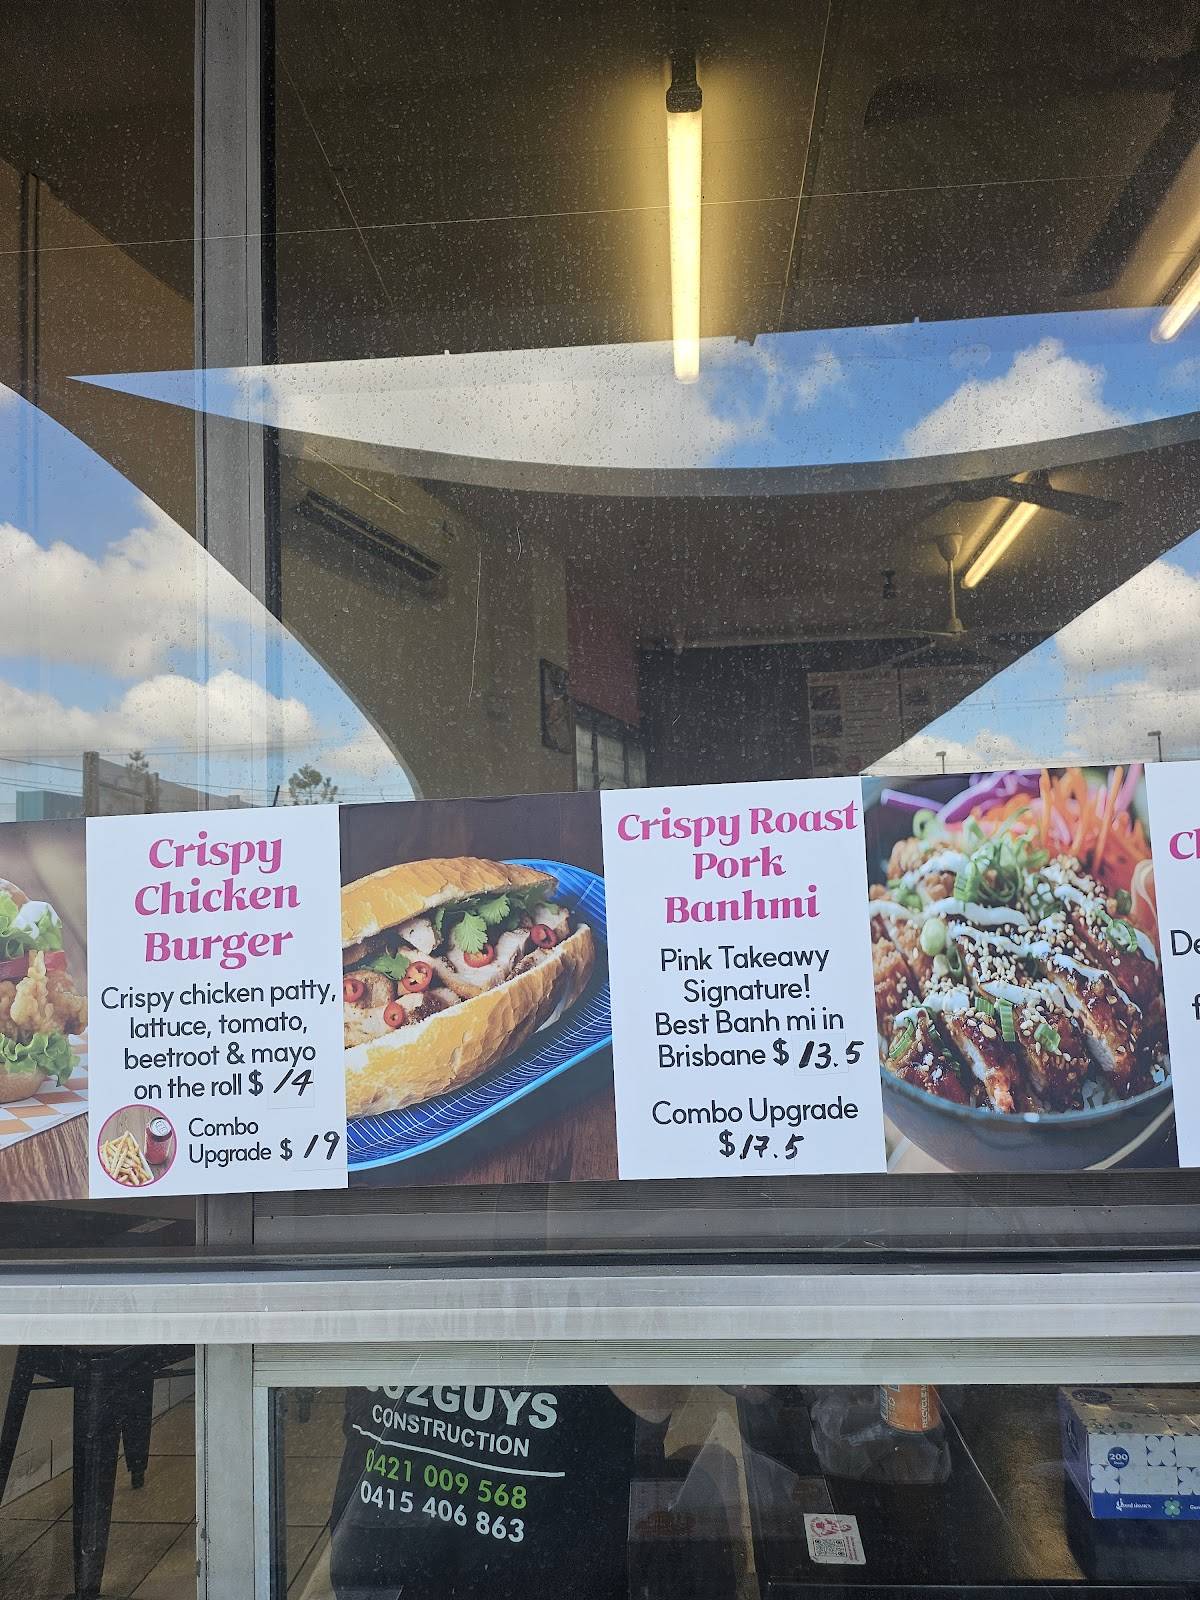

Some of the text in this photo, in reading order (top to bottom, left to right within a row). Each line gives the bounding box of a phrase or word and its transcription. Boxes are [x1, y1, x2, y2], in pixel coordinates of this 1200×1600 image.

[617, 801, 858, 848] Crispy Roast
[148, 831, 282, 875] Crispy
[693, 846, 787, 881] Pork
[134, 877, 301, 917] Chicken
[665, 884, 822, 924] Banhmi
[145, 930, 294, 970] Burger
[660, 945, 830, 972] Pink Takeawy
[101, 979, 336, 1014] Crispy chicken patty,
[683, 973, 812, 1008] Signature!
[130, 1011, 308, 1039] lattuce, tomato,
[655, 1006, 844, 1036] Best Banh mi in
[124, 1041, 316, 1070] beetroot & mayo
[658, 1043, 767, 1068] Brisbane
[134, 1082, 162, 1100] on
[167, 1075, 206, 1099] the
[211, 1072, 243, 1097] roll
[188, 1116, 259, 1138] Combo
[652, 1095, 859, 1128] Combo Upgrade
[188, 1141, 272, 1169] Upgrade
[372, 1404, 530, 1457] CONSTRUCTION
[1109, 1453, 1128, 1461] 200
[366, 1448, 528, 1510] 0421 009 568
[360, 1480, 525, 1543] 0415 406 863
